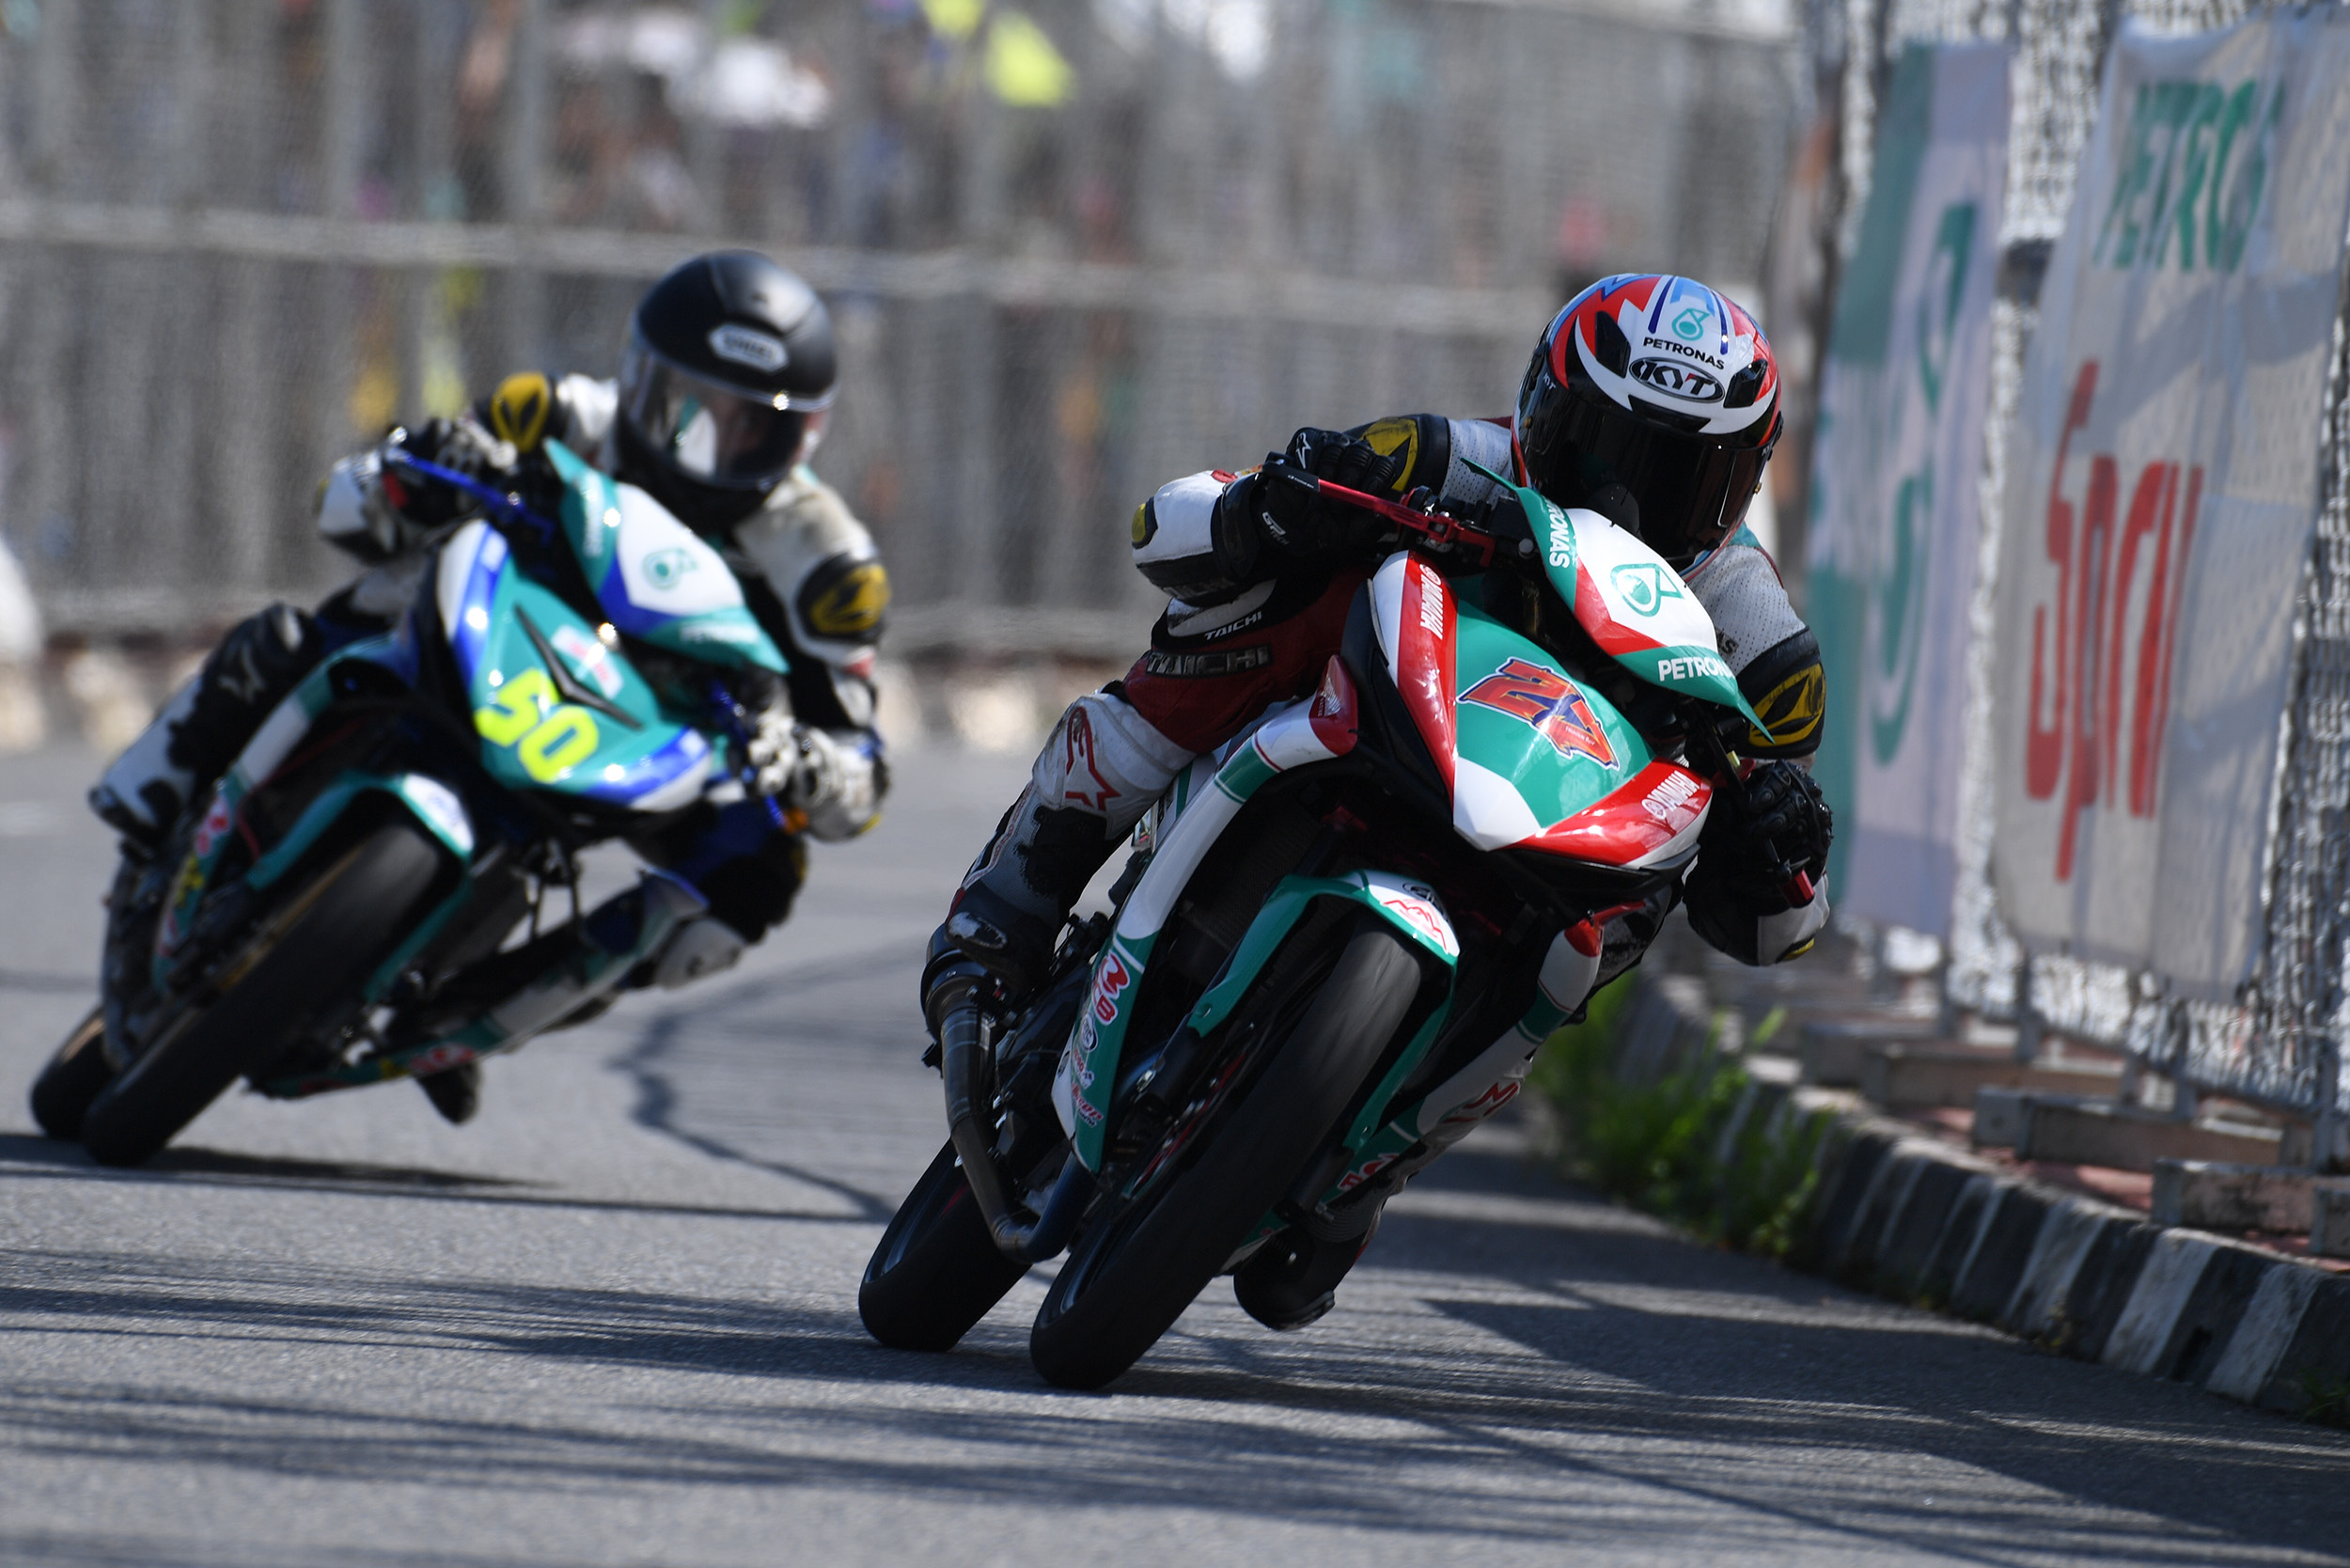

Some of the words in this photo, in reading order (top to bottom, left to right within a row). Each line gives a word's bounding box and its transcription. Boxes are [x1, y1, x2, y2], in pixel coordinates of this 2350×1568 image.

[1642, 337, 1725, 370] PETRONAS
[1638, 361, 1715, 396] KYT
[1204, 611, 1263, 641] TAICHI
[1419, 573, 1444, 640] YAMAHA
[474, 668, 599, 783] 50
[1646, 769, 1700, 812] YAMAHA
